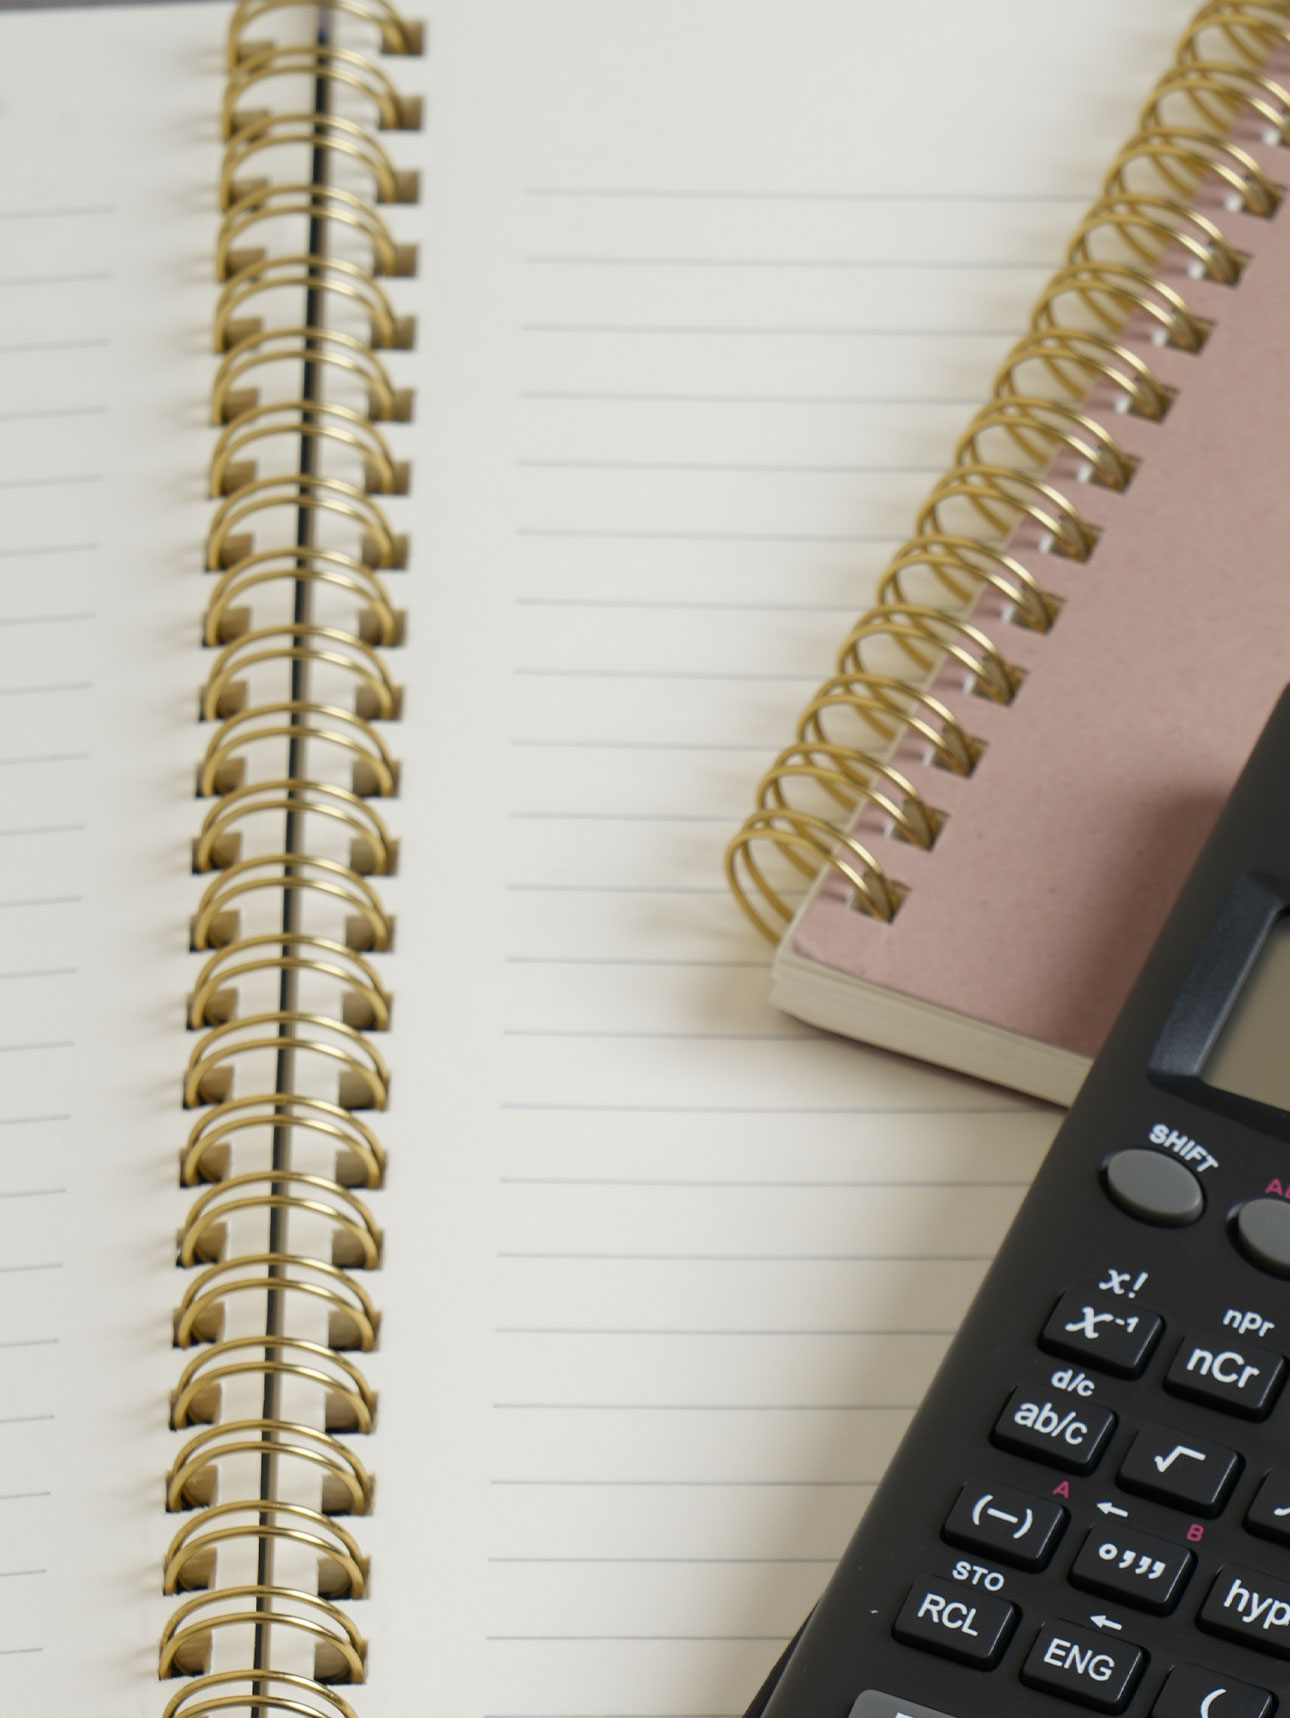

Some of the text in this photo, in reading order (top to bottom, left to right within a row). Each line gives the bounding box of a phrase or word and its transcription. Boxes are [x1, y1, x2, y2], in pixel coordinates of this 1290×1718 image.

[1149, 1124, 1219, 1172] SHIFT
[1051, 1369, 1095, 1397] d/c
[1186, 1348, 1260, 1388] nCr
[1014, 1402, 1088, 1445] ab/c
[1052, 1479, 1070, 1498] A
[1186, 1523, 1205, 1542] B
[952, 1561, 1005, 1592] STO
[917, 1593, 978, 1637] RCL
[1043, 1638, 1115, 1681] ENG
